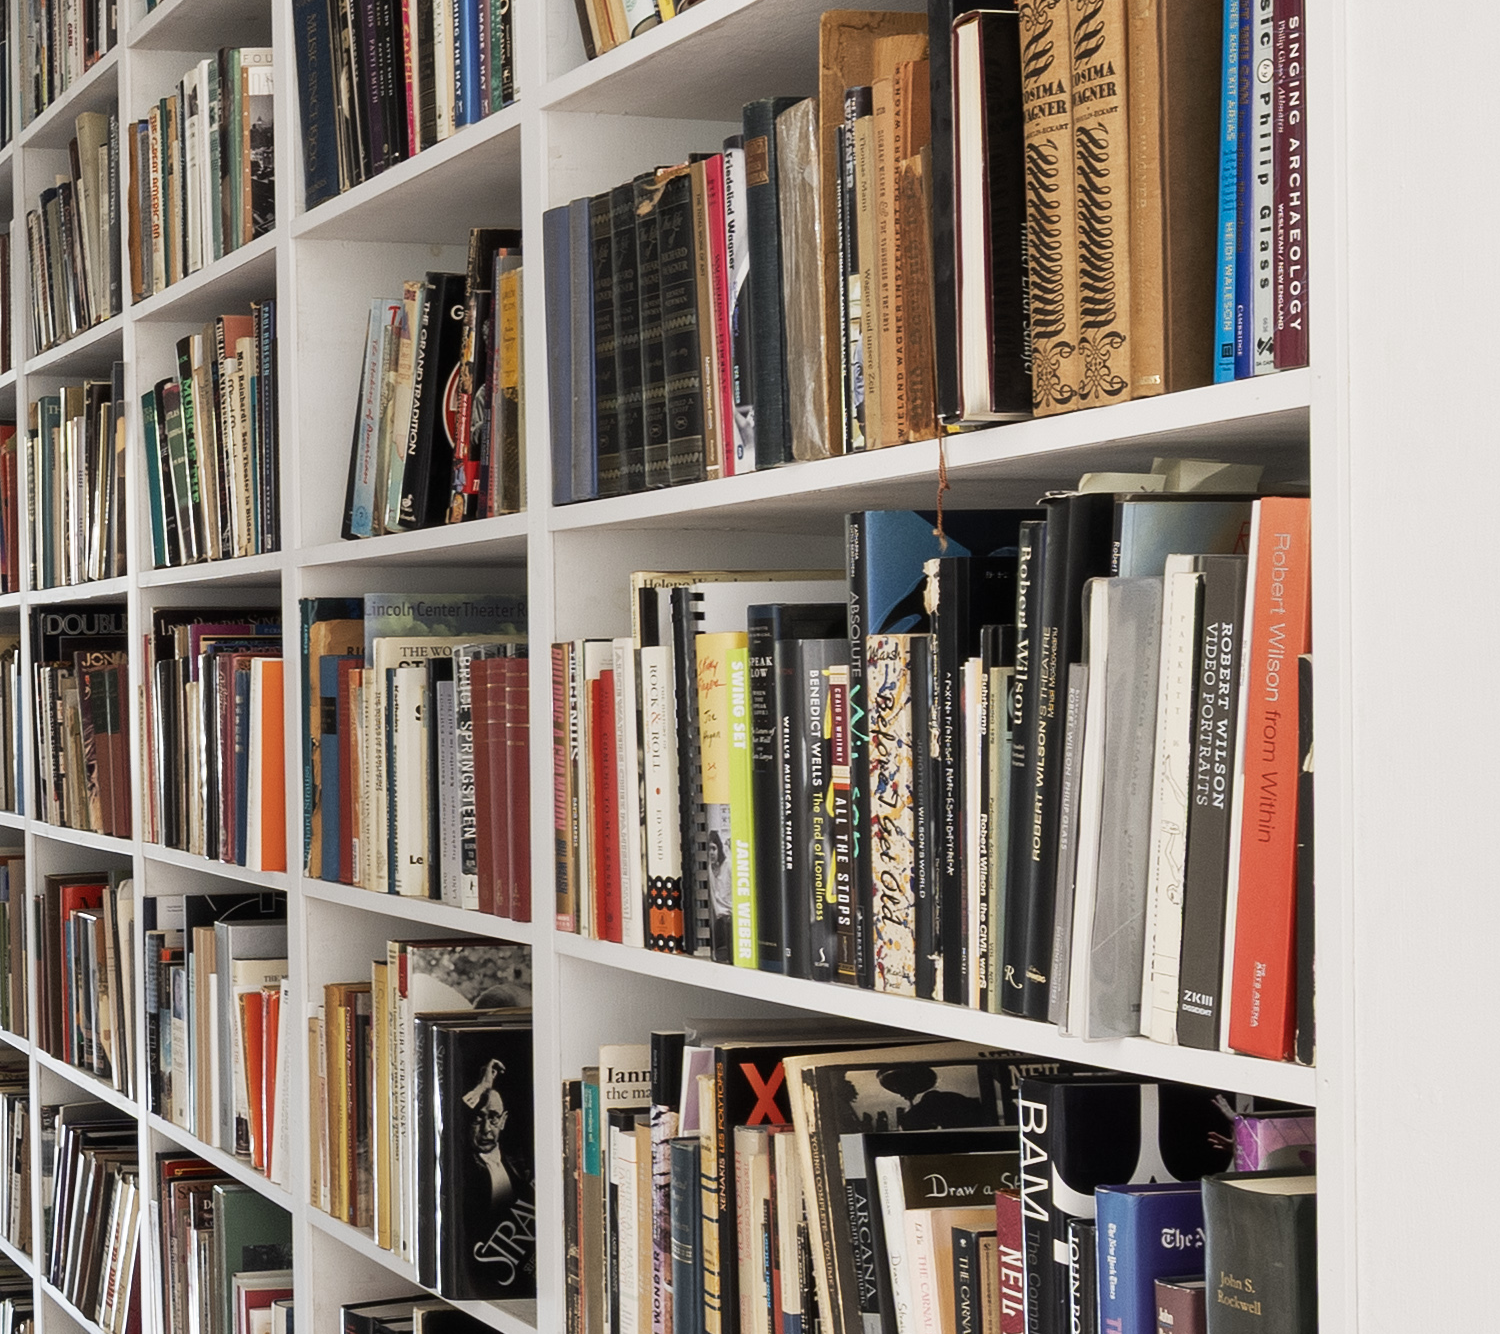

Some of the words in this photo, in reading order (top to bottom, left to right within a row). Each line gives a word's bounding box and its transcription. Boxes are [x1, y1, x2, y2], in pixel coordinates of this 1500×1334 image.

[1288, 14, 1301, 116] SINGING
[1257, 91, 1272, 189] Philip
[1257, 203, 1270, 290] Glass
[1288, 126, 1302, 332] ARCHAEOLOGY
[1272, 533, 1292, 615] Robert
[458, 655, 472, 714] BRUCE
[730, 660, 746, 709] SWING
[1265, 622, 1286, 701] Wilson
[731, 717, 747, 750] SET
[1262, 710, 1278, 761] from
[460, 721, 477, 839] SPRINGSTEEN
[1257, 771, 1276, 845] Within
[1018, 1097, 1050, 1223] BAM
[997, 1246, 1023, 1323] NEIL
